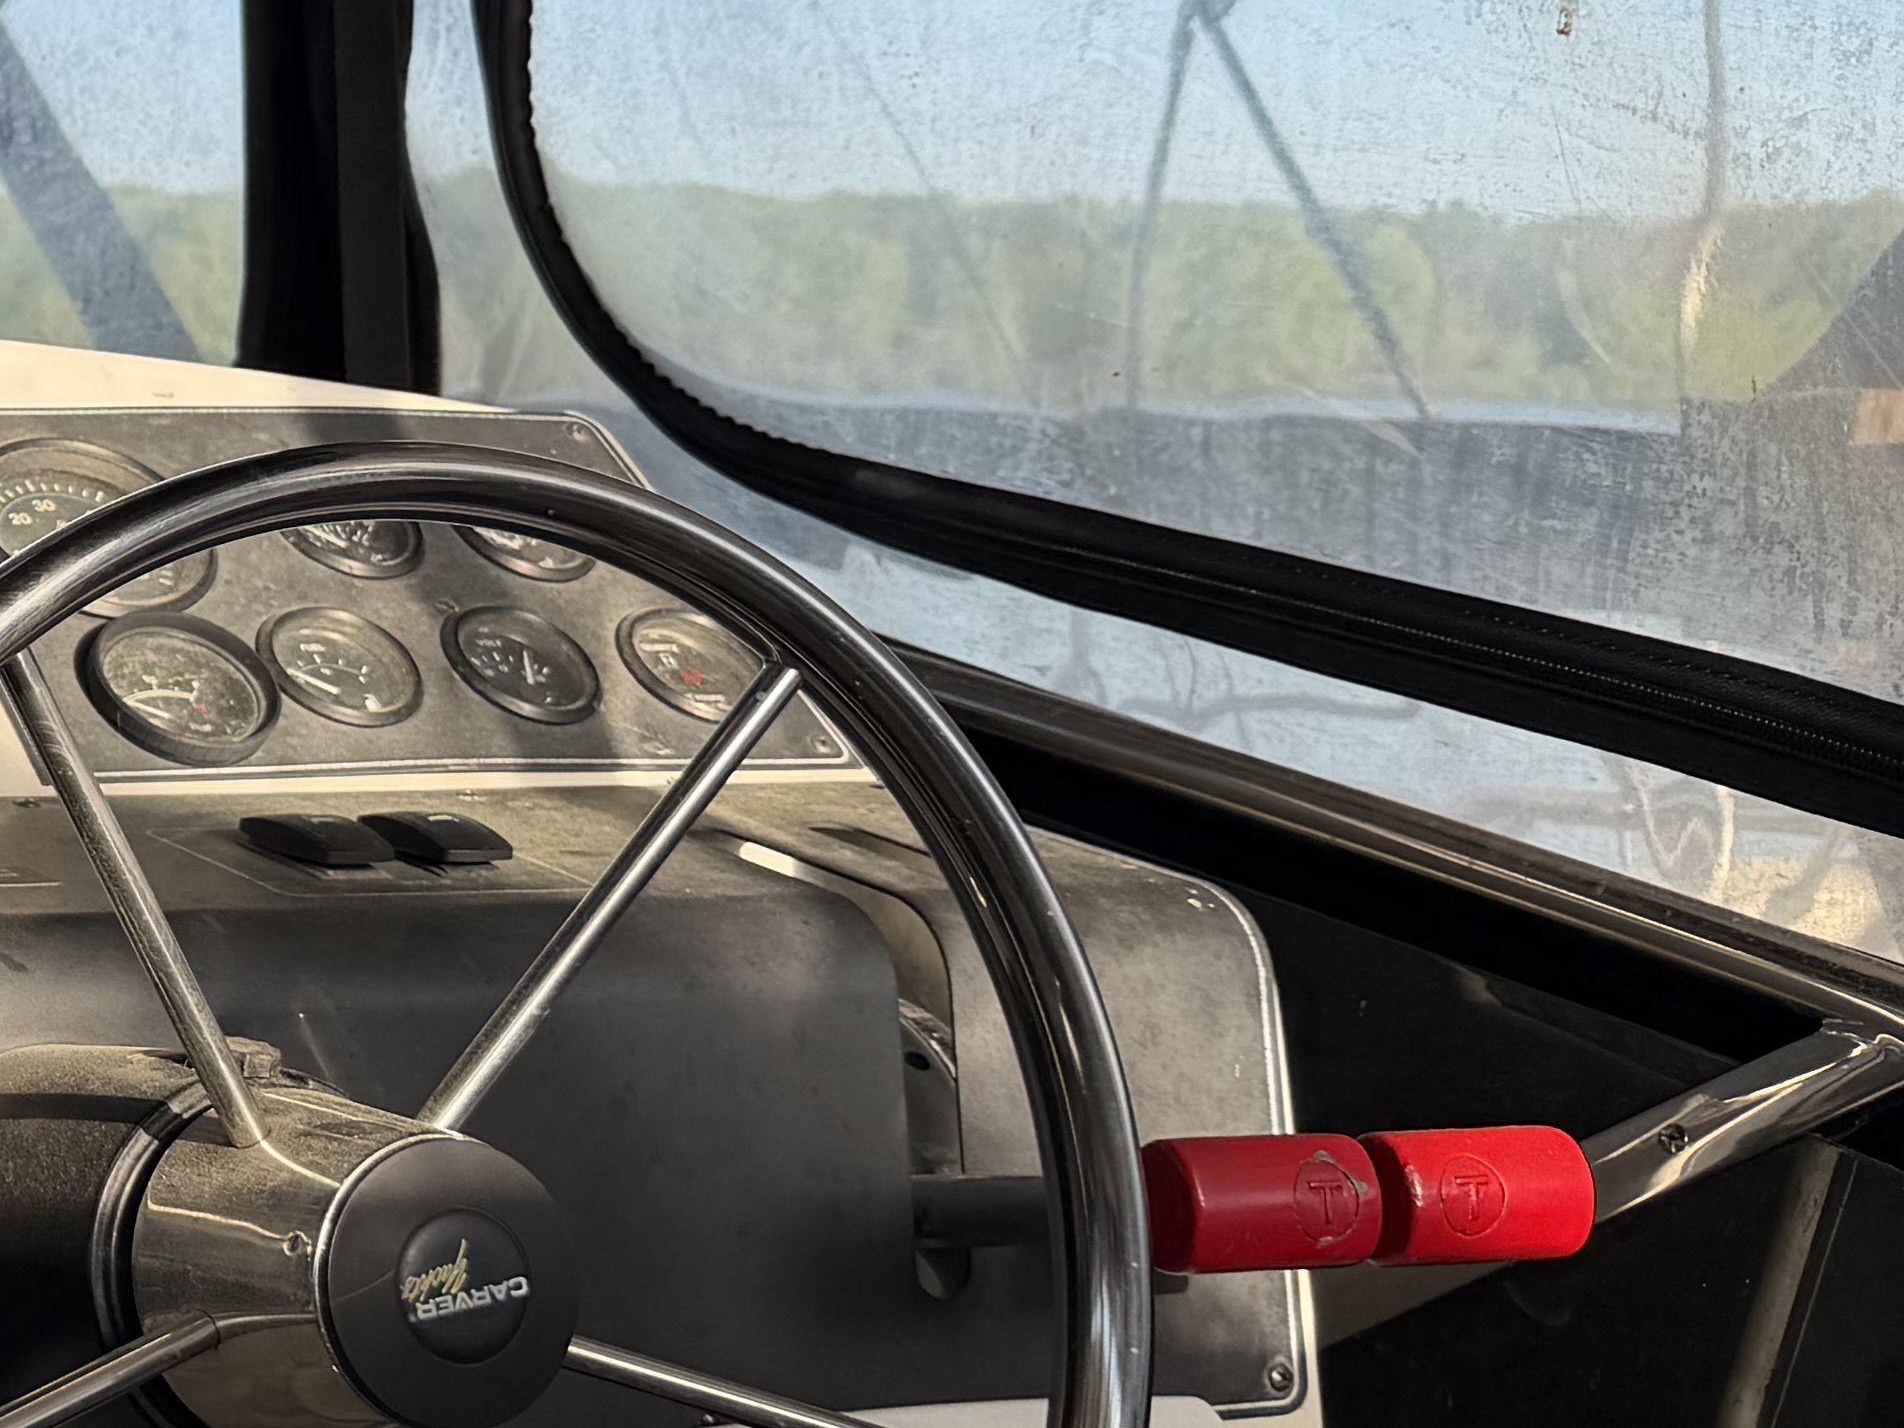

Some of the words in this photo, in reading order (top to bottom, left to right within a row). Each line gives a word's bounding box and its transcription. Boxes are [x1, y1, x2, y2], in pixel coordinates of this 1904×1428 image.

[31, 498, 57, 512] 30
[8, 511, 33, 526] 20
[415, 1275, 530, 1321] CARVER
